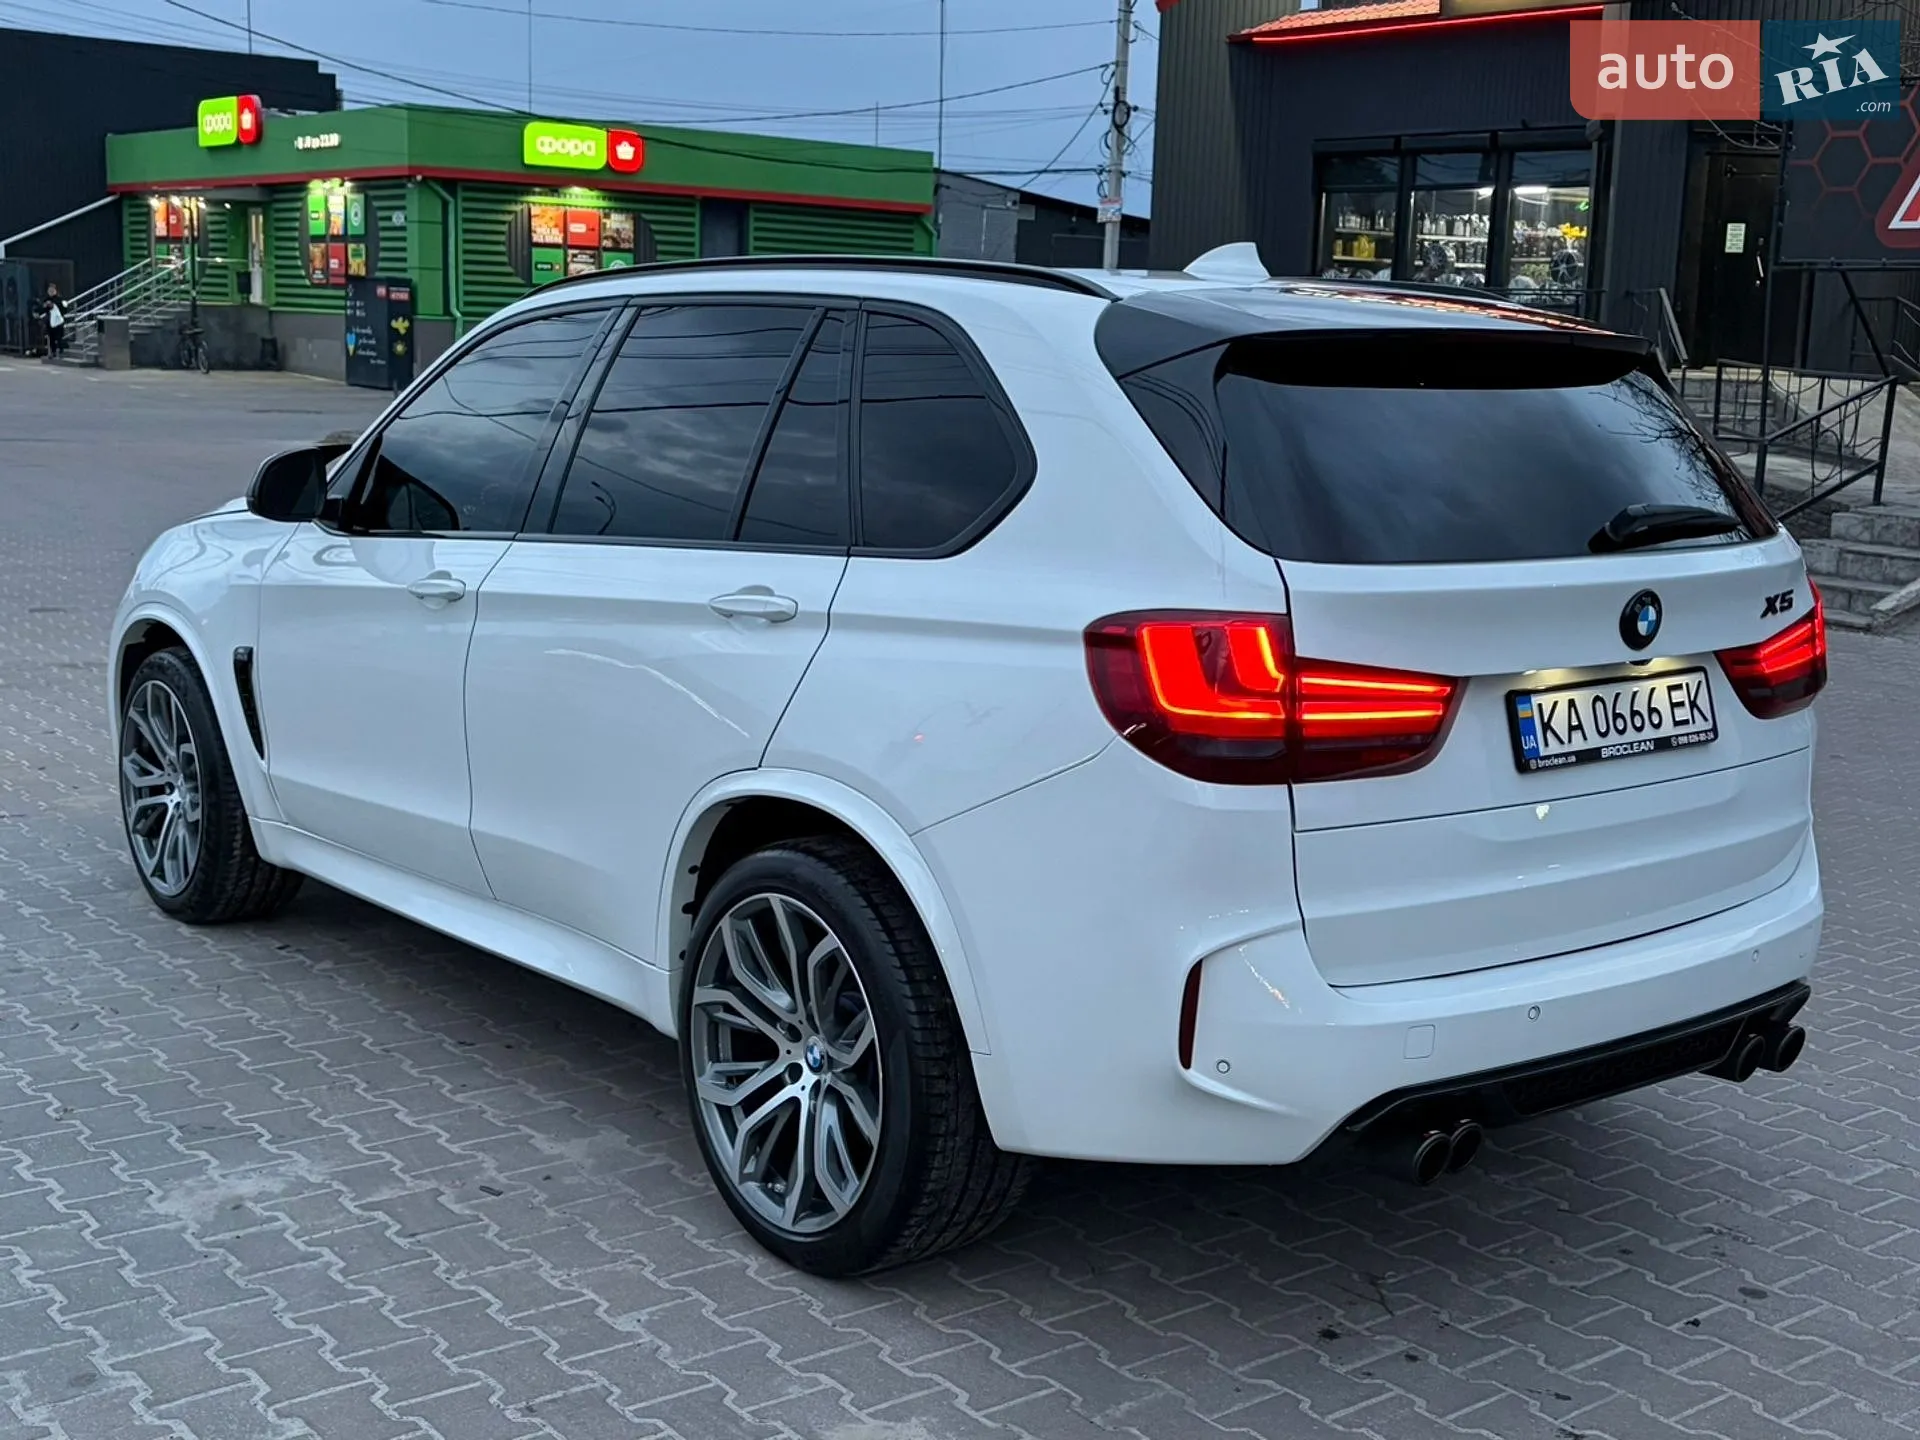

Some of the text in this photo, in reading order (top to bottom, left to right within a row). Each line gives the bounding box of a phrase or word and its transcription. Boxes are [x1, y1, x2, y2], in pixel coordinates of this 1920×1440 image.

[535, 135, 597, 157] фора
[1760, 588, 1795, 619] X5
[1537, 679, 1709, 748] KA 0666 EK
[1521, 735, 1538, 750] UA
[1601, 739, 1655, 759] BROCLEAN
